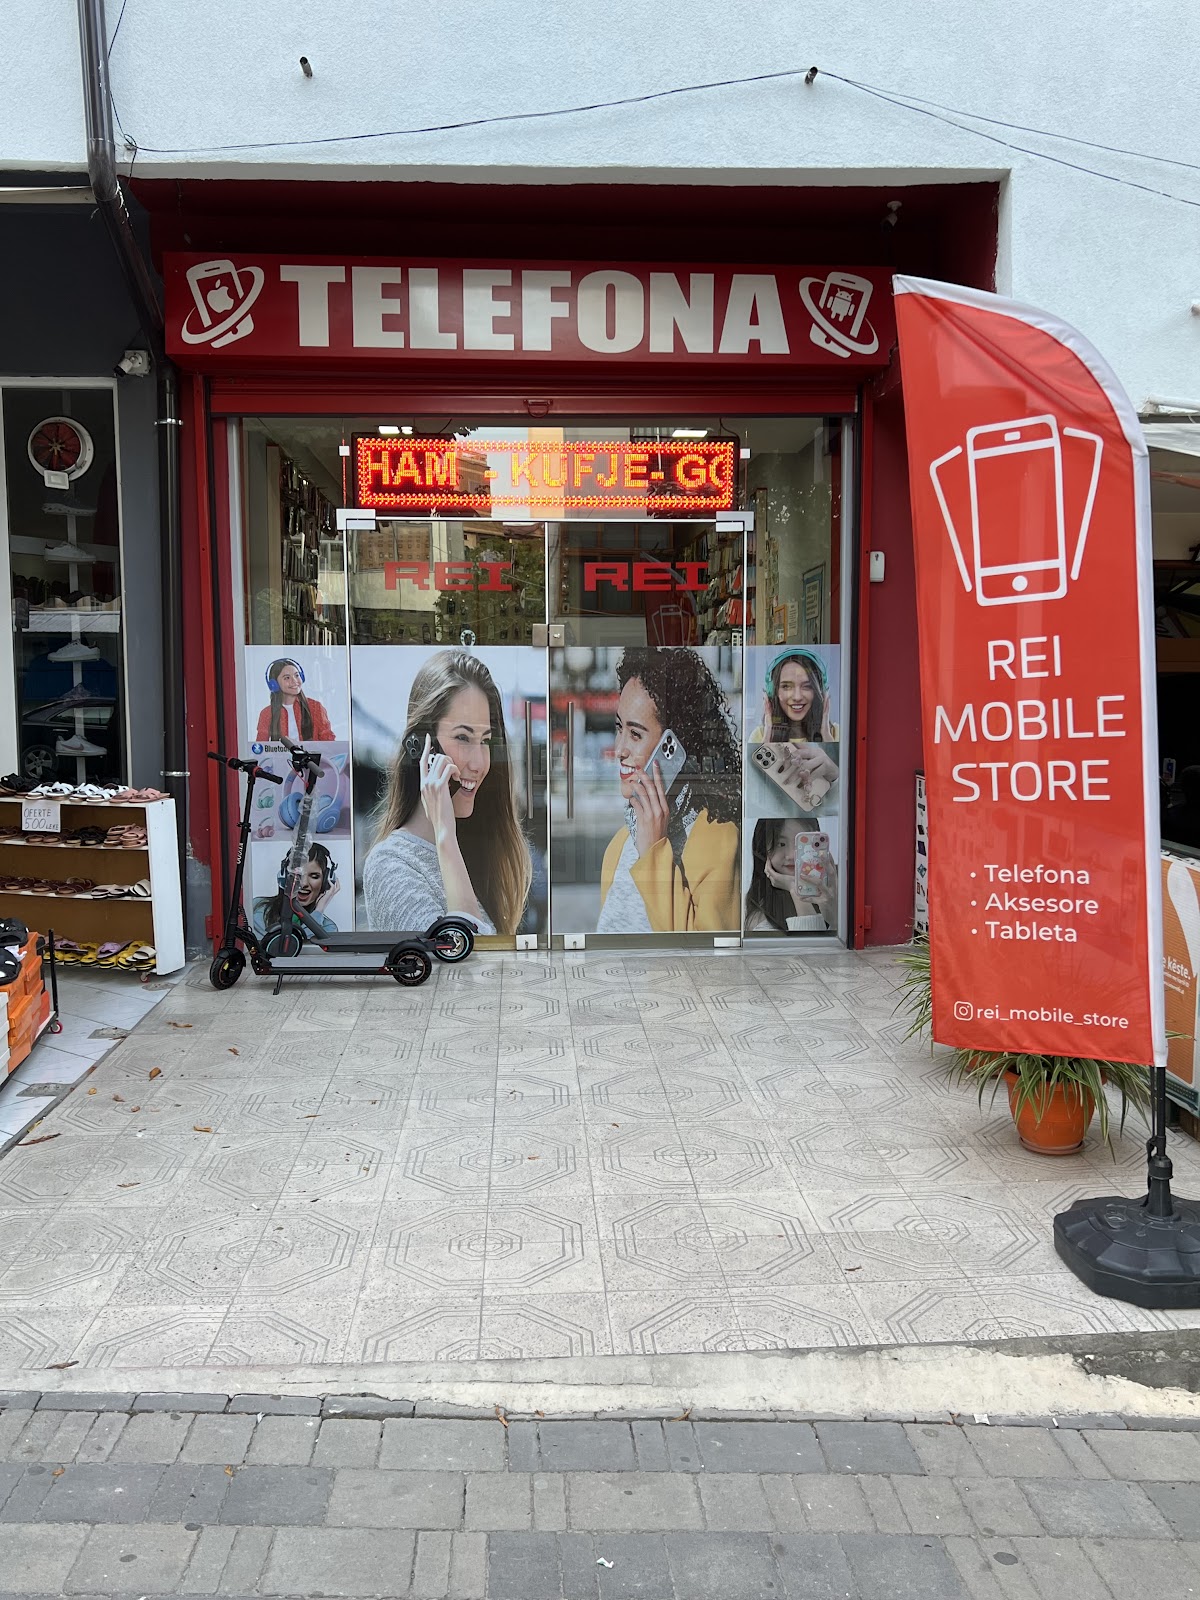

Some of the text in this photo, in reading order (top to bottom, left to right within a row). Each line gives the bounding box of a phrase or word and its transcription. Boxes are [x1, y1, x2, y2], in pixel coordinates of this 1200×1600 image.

[279, 264, 791, 356] TELEFONA
[368, 450, 457, 486] HAM
[384, 561, 513, 591] REI
[584, 562, 709, 592] REI
[987, 635, 1062, 681] REI
[934, 695, 1126, 744] MOBILE
[264, 744, 291, 753] Bluetoo
[952, 759, 1111, 802] STORE
[24, 807, 52, 818] OFERTE
[24, 817, 47, 830] 500
[983, 863, 1090, 885] Telefona
[984, 892, 1099, 915] Aksesore
[984, 921, 1078, 943] Tableta
[976, 1004, 1129, 1029] rei_mobile_store
